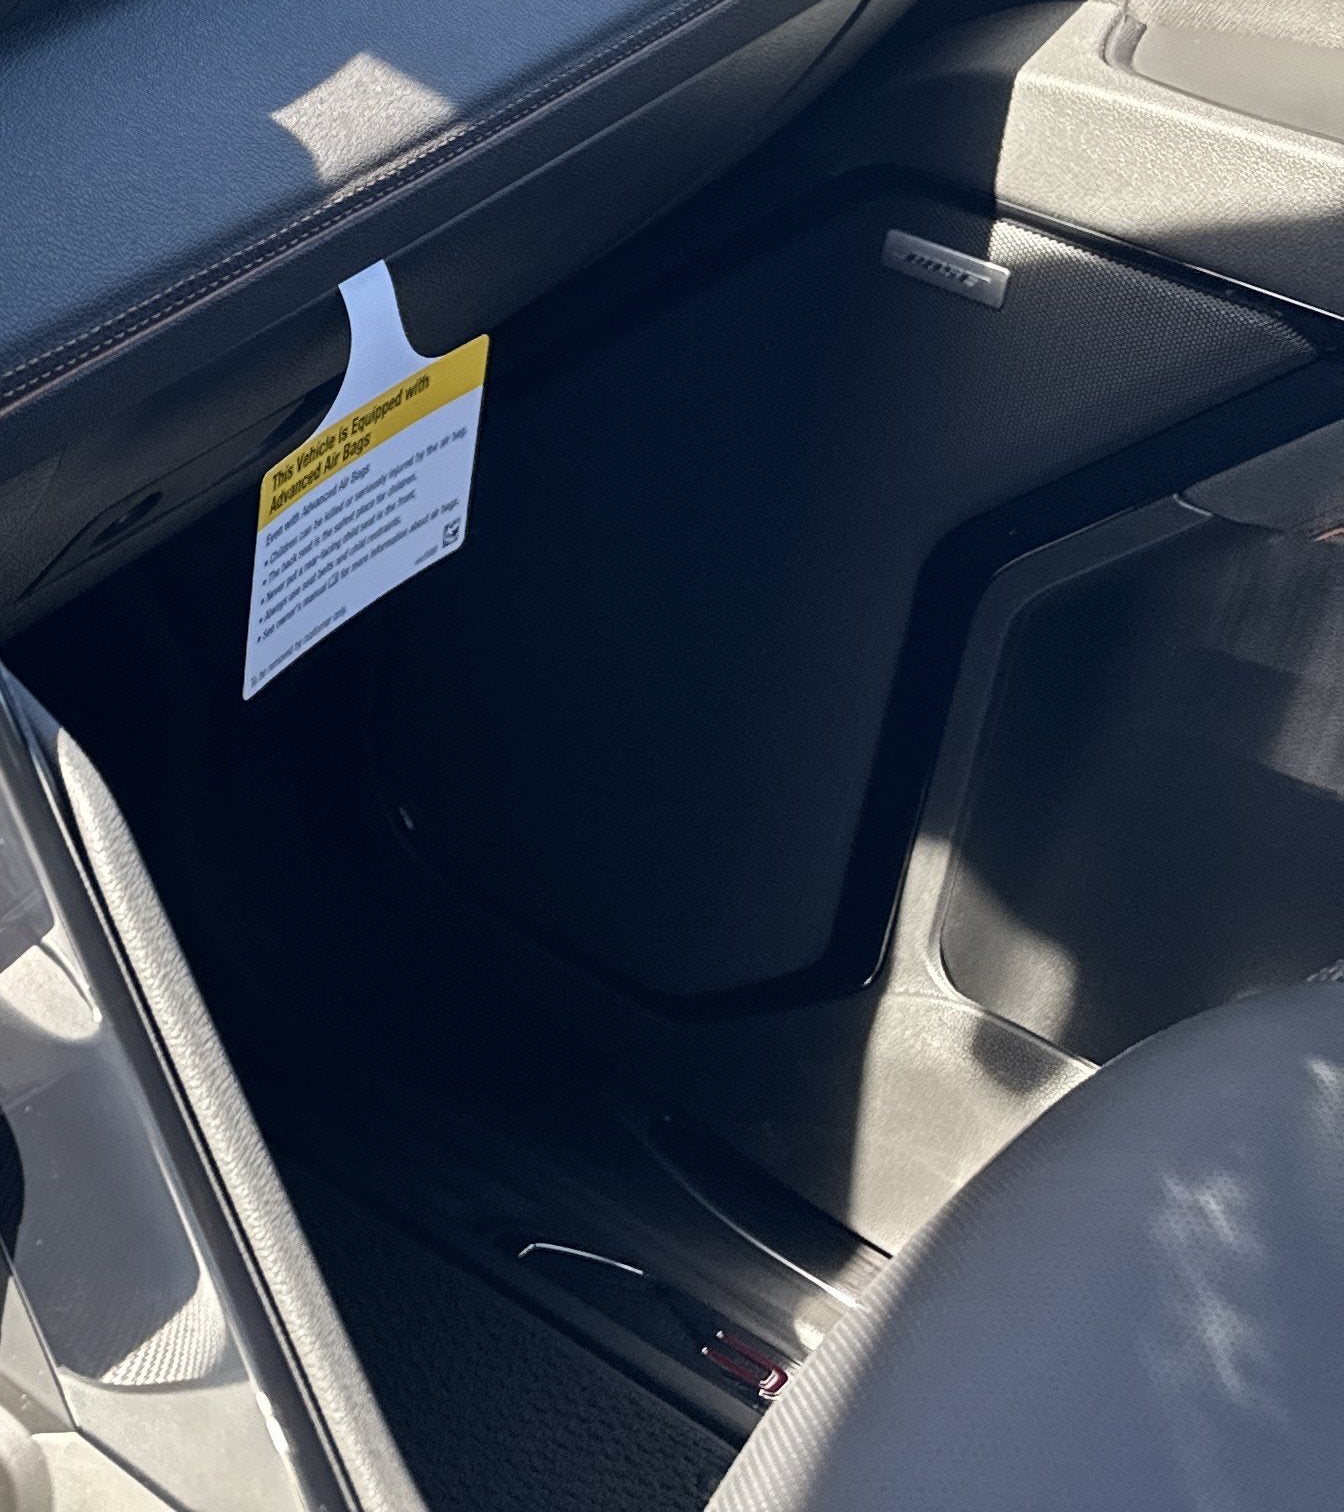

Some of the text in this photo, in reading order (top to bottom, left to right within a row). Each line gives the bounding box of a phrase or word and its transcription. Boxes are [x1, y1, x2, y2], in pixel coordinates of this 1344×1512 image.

[269, 432, 370, 514] Advanced Air Bags
[272, 375, 429, 491] This Vehicle is Equipped with
